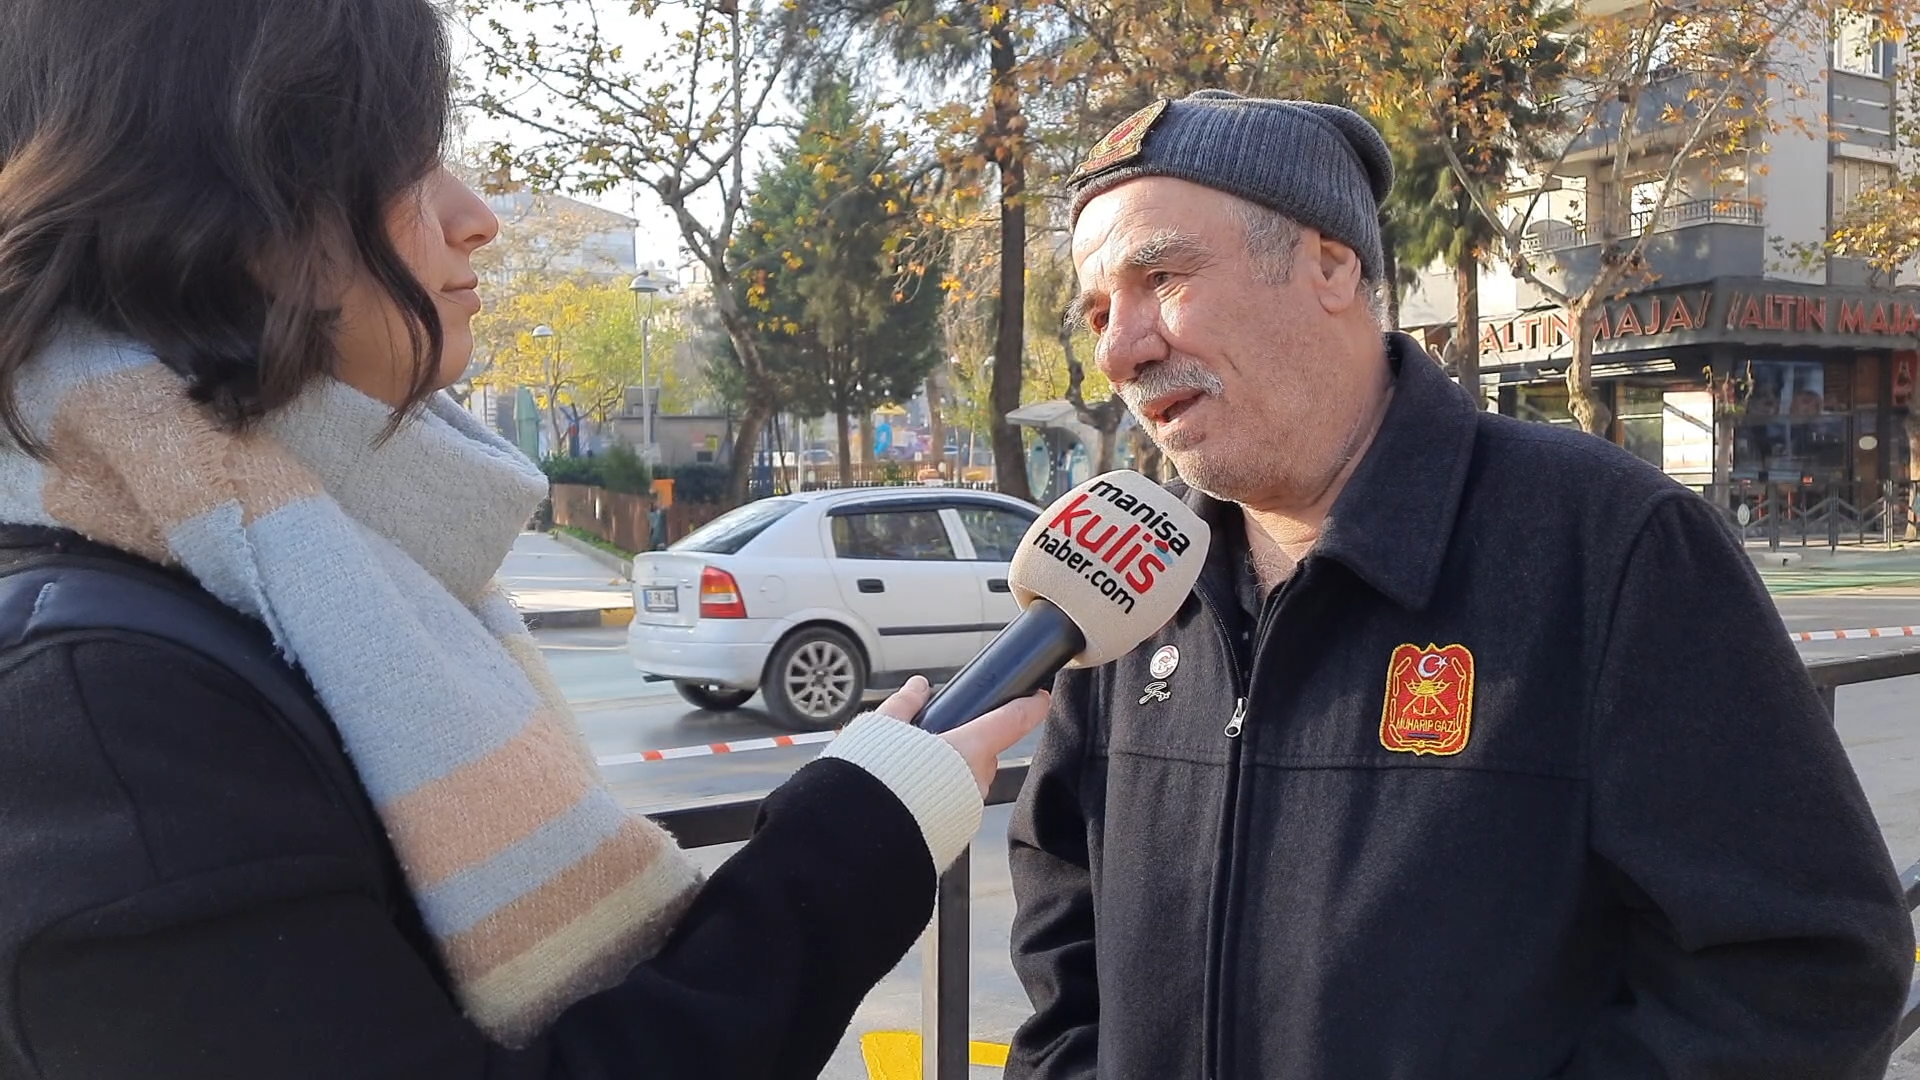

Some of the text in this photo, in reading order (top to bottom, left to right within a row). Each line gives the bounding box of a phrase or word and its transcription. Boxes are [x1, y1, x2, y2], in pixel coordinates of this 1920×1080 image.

[1478, 310, 1575, 355] ALTIN
[1739, 293, 1919, 334] ALTIN MAJA
[1048, 493, 1166, 595] kulis
[1088, 480, 1191, 557] manisa
[1033, 528, 1136, 614] haber.com
